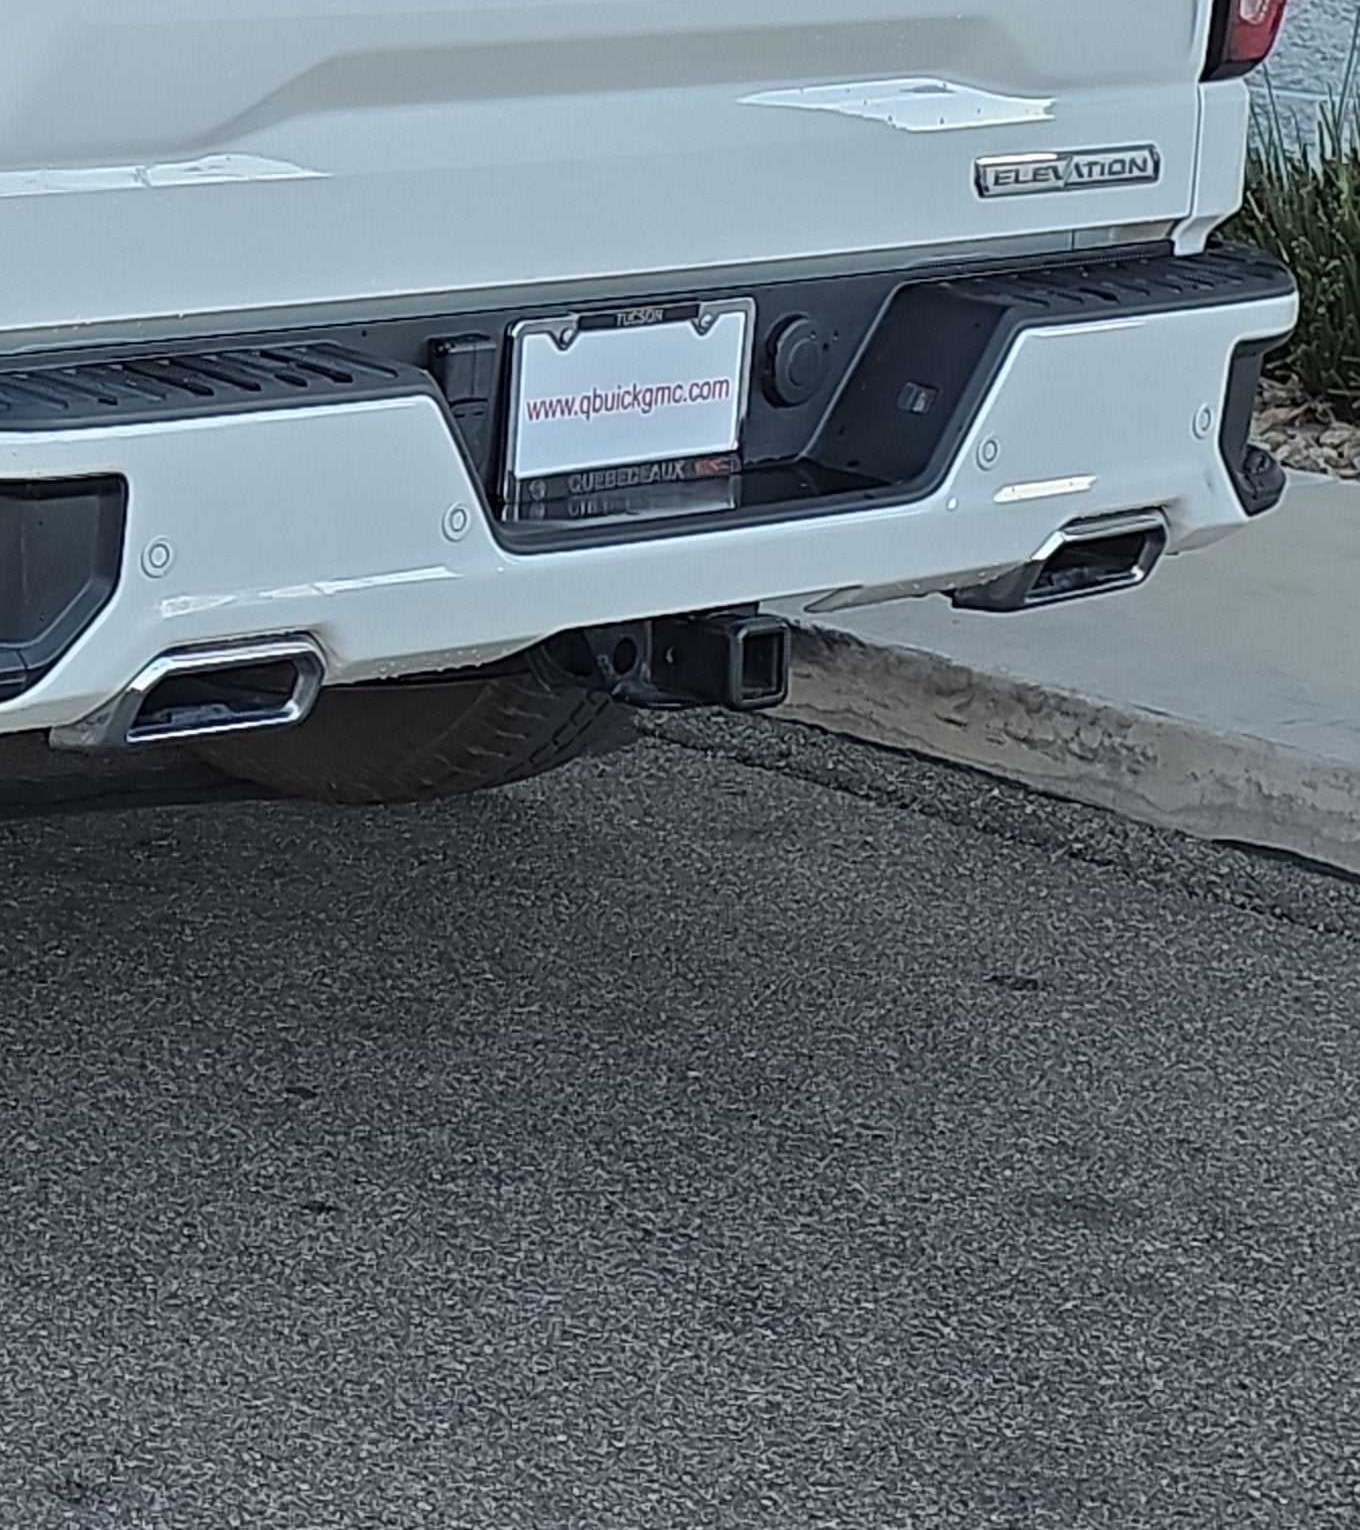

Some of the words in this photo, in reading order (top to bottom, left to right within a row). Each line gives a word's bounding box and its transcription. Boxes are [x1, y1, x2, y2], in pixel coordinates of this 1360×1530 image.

[992, 156, 1148, 187] ELEVATION
[616, 308, 664, 327] TUCSON
[526, 377, 730, 422] www.qbuickgmc.com
